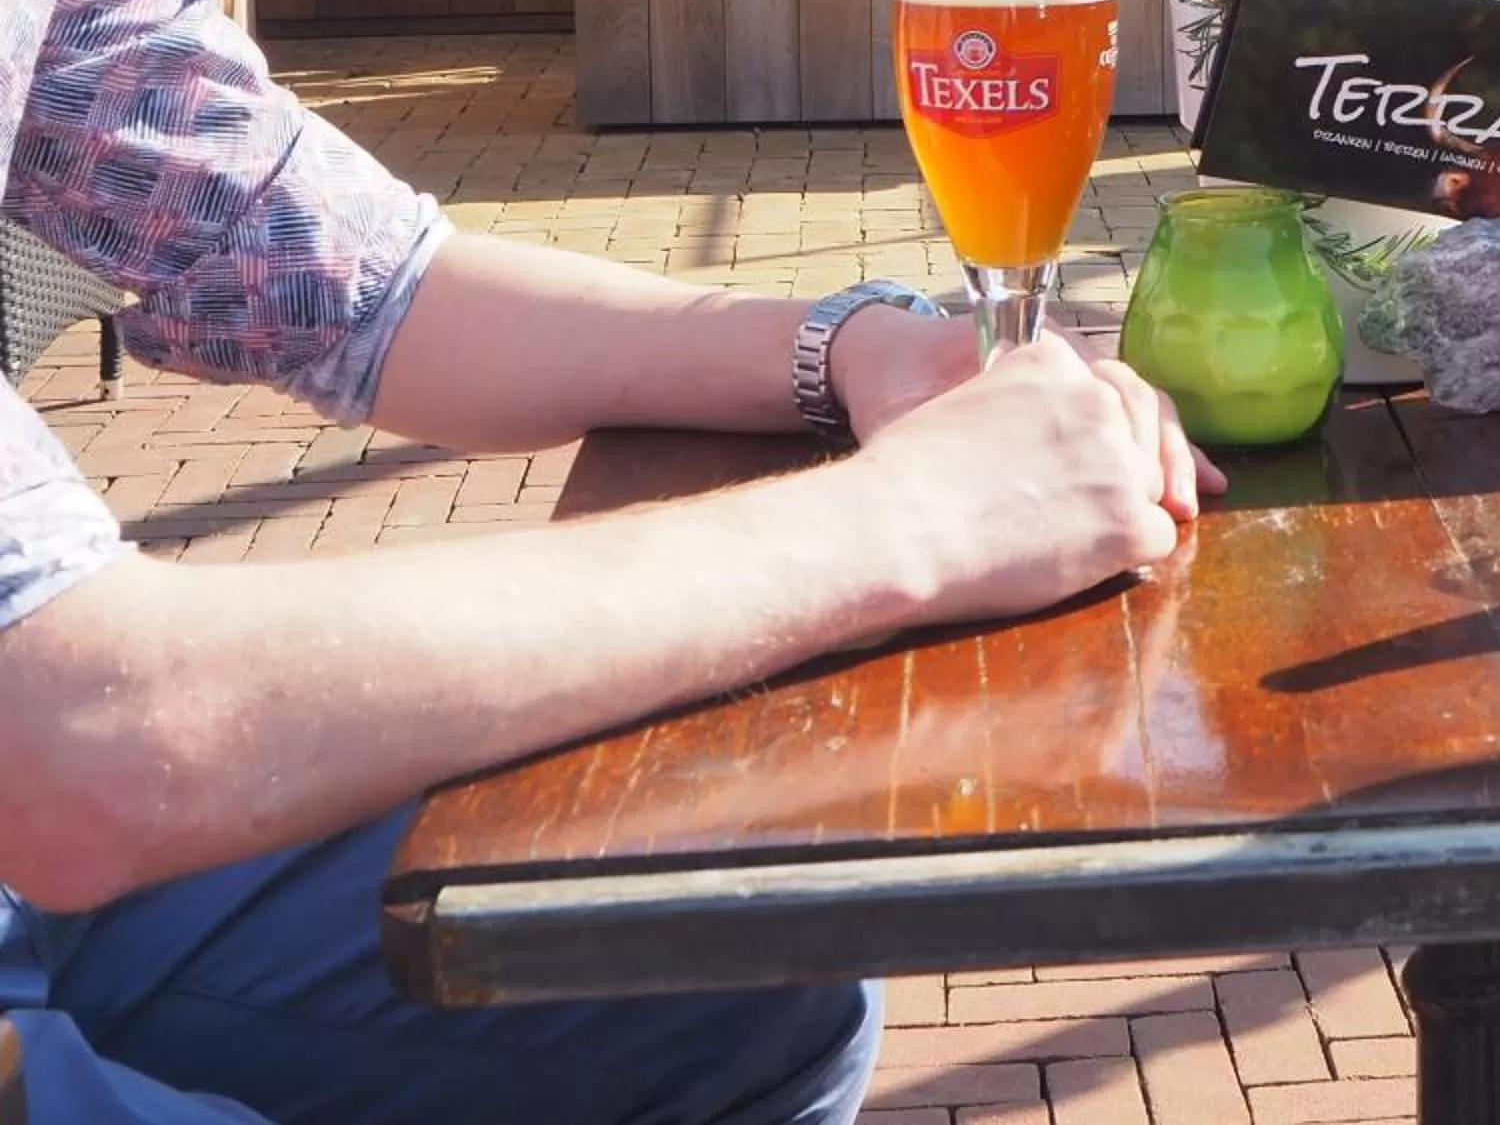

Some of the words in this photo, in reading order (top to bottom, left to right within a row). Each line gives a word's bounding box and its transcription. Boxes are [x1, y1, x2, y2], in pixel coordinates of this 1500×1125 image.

[911, 62, 1049, 110] TEXELS
[1313, 129, 1373, 149] DRANKEN
[1383, 141, 1430, 160] BIEREN
